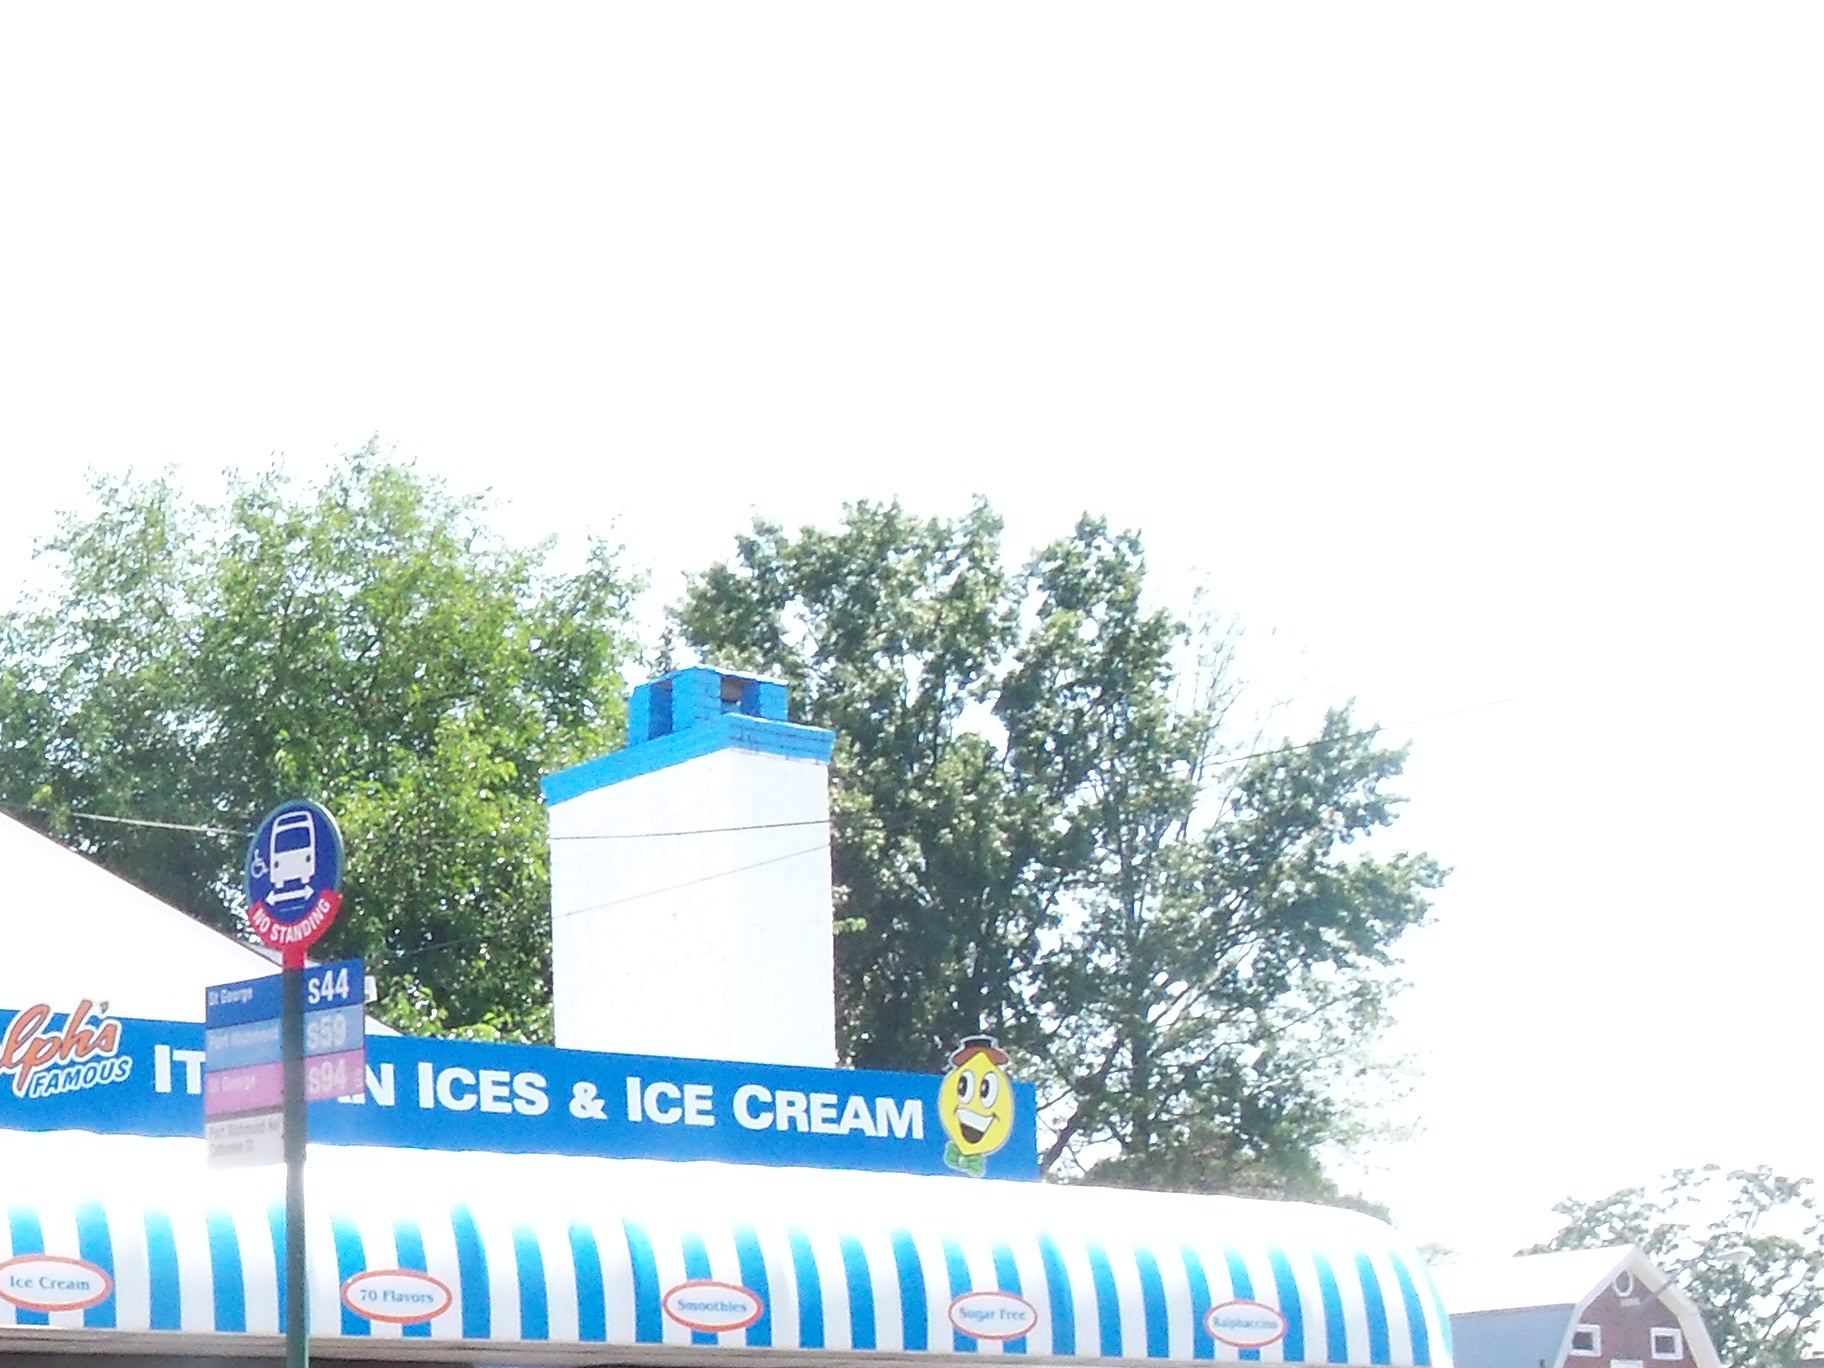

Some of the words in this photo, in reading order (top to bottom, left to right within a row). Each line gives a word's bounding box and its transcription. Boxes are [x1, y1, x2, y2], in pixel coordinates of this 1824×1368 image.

[252, 908, 269, 932] NO
[269, 900, 331, 943] STANDING
[307, 967, 350, 1004] S44
[29, 1057, 131, 1099] FAMOUS
[307, 1058, 347, 1095] S94
[418, 1062, 550, 1116] ICES
[568, 1079, 607, 1120] &
[626, 1076, 716, 1127] ICE
[733, 1084, 923, 1140] CREAM
[9, 1275, 33, 1290] Ice
[38, 1275, 90, 1292] Cream
[360, 1288, 378, 1302] 70
[382, 1289, 435, 1305] Flavors
[676, 1299, 749, 1314] Smoothies
[959, 1306, 994, 1324] Sugar
